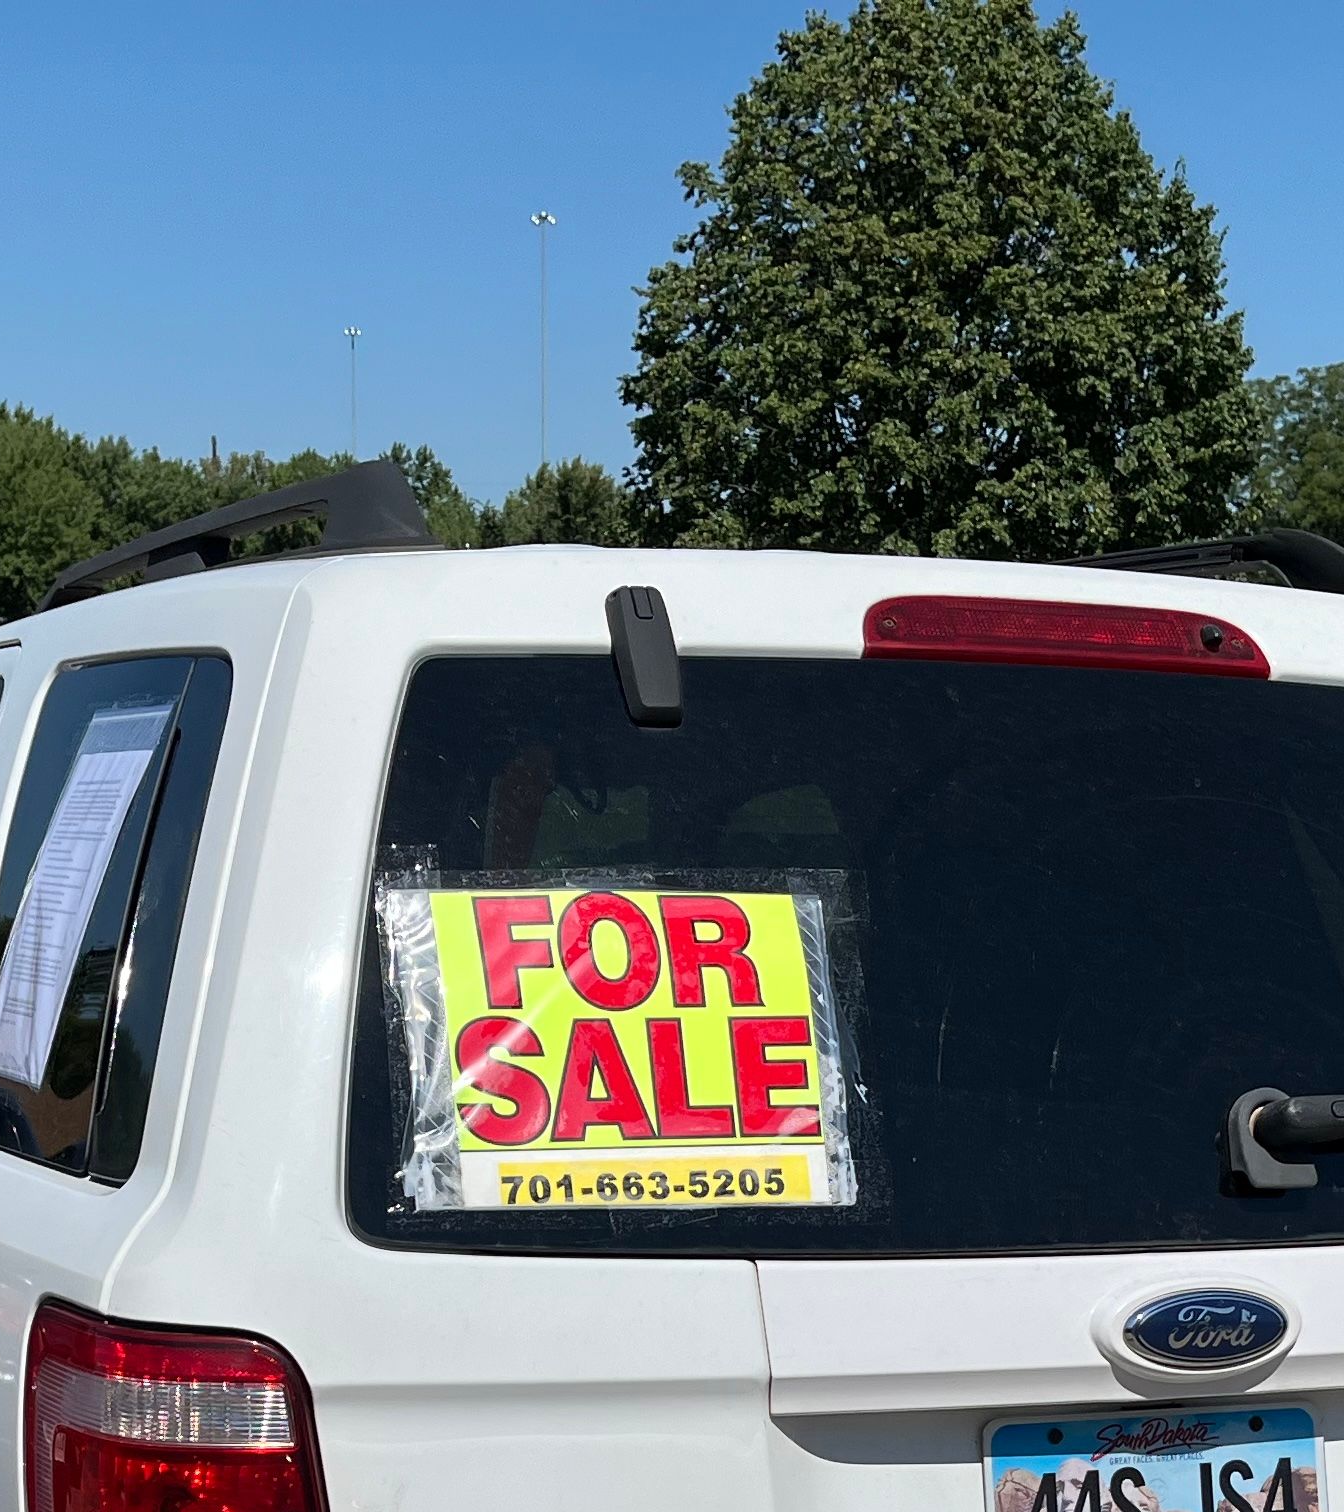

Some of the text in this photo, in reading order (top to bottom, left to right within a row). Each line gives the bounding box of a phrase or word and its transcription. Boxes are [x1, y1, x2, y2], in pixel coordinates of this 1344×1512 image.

[471, 890, 766, 1012] FOR
[455, 1016, 822, 1147] SALE
[500, 1167, 786, 1205] 701-663-5205
[1167, 1304, 1257, 1350] Ford
